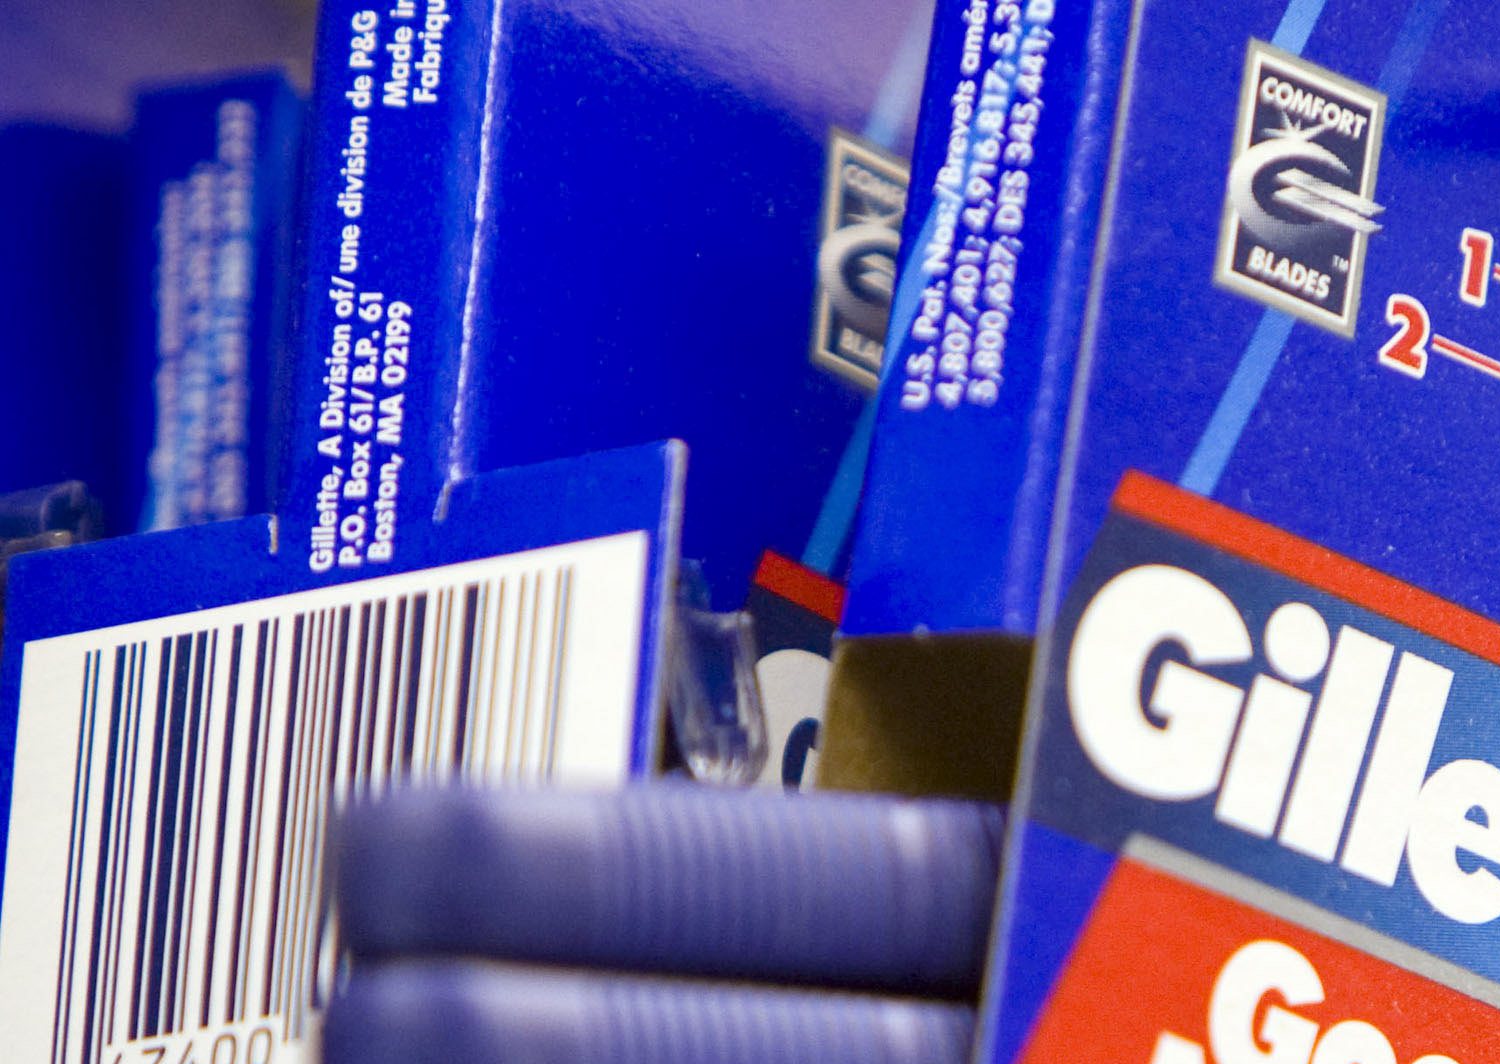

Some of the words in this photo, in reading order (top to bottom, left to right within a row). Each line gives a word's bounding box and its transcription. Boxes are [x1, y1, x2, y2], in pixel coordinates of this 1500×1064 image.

[348, 10, 379, 69] P&G
[988, 0, 1022, 56] 5,3
[345, 74, 373, 109] de
[382, 25, 414, 108] Made
[1003, 25, 1055, 168] 345,441;
[1261, 76, 1367, 139] COMFORT
[336, 115, 370, 219] division
[962, 58, 1016, 234] 4,916,817;
[991, 169, 1030, 235] DES
[1247, 245, 1332, 299] BLADES
[1459, 227, 1494, 308] 1
[358, 291, 384, 323] 61
[911, 279, 947, 342] Pat.
[935, 234, 989, 411] 4,807,401;
[1377, 293, 1431, 380] 2
[319, 324, 352, 429] Division
[380, 300, 413, 388] 02199
[901, 345, 937, 411] U.S.
[317, 434, 342, 458] A
[376, 393, 405, 444] MA
[343, 440, 372, 500] Box
[309, 465, 344, 573] Gillette,
[338, 504, 367, 567] P.O.
[367, 452, 405, 563] Boston,
